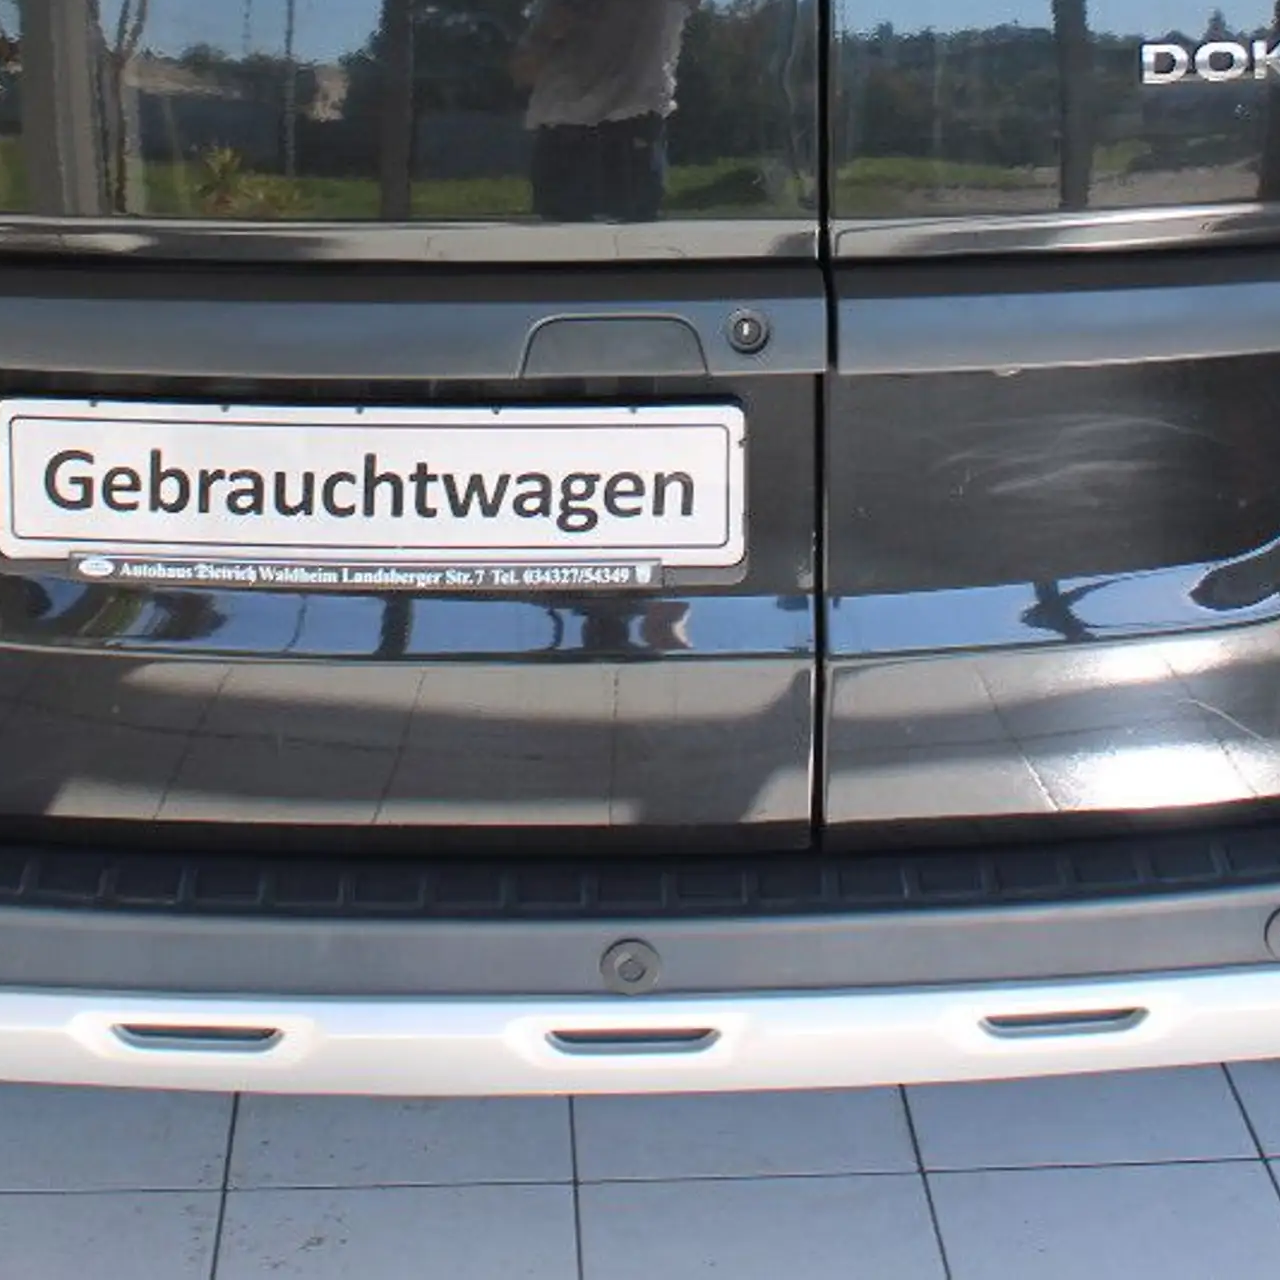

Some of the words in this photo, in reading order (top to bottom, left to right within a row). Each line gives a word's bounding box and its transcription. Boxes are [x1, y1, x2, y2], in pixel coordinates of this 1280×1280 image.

[44, 448, 694, 530] Gebrauchtwagen
[120, 562, 192, 579] Autohaus
[259, 567, 338, 584] Waldheim
[491, 569, 519, 585] Tel.
